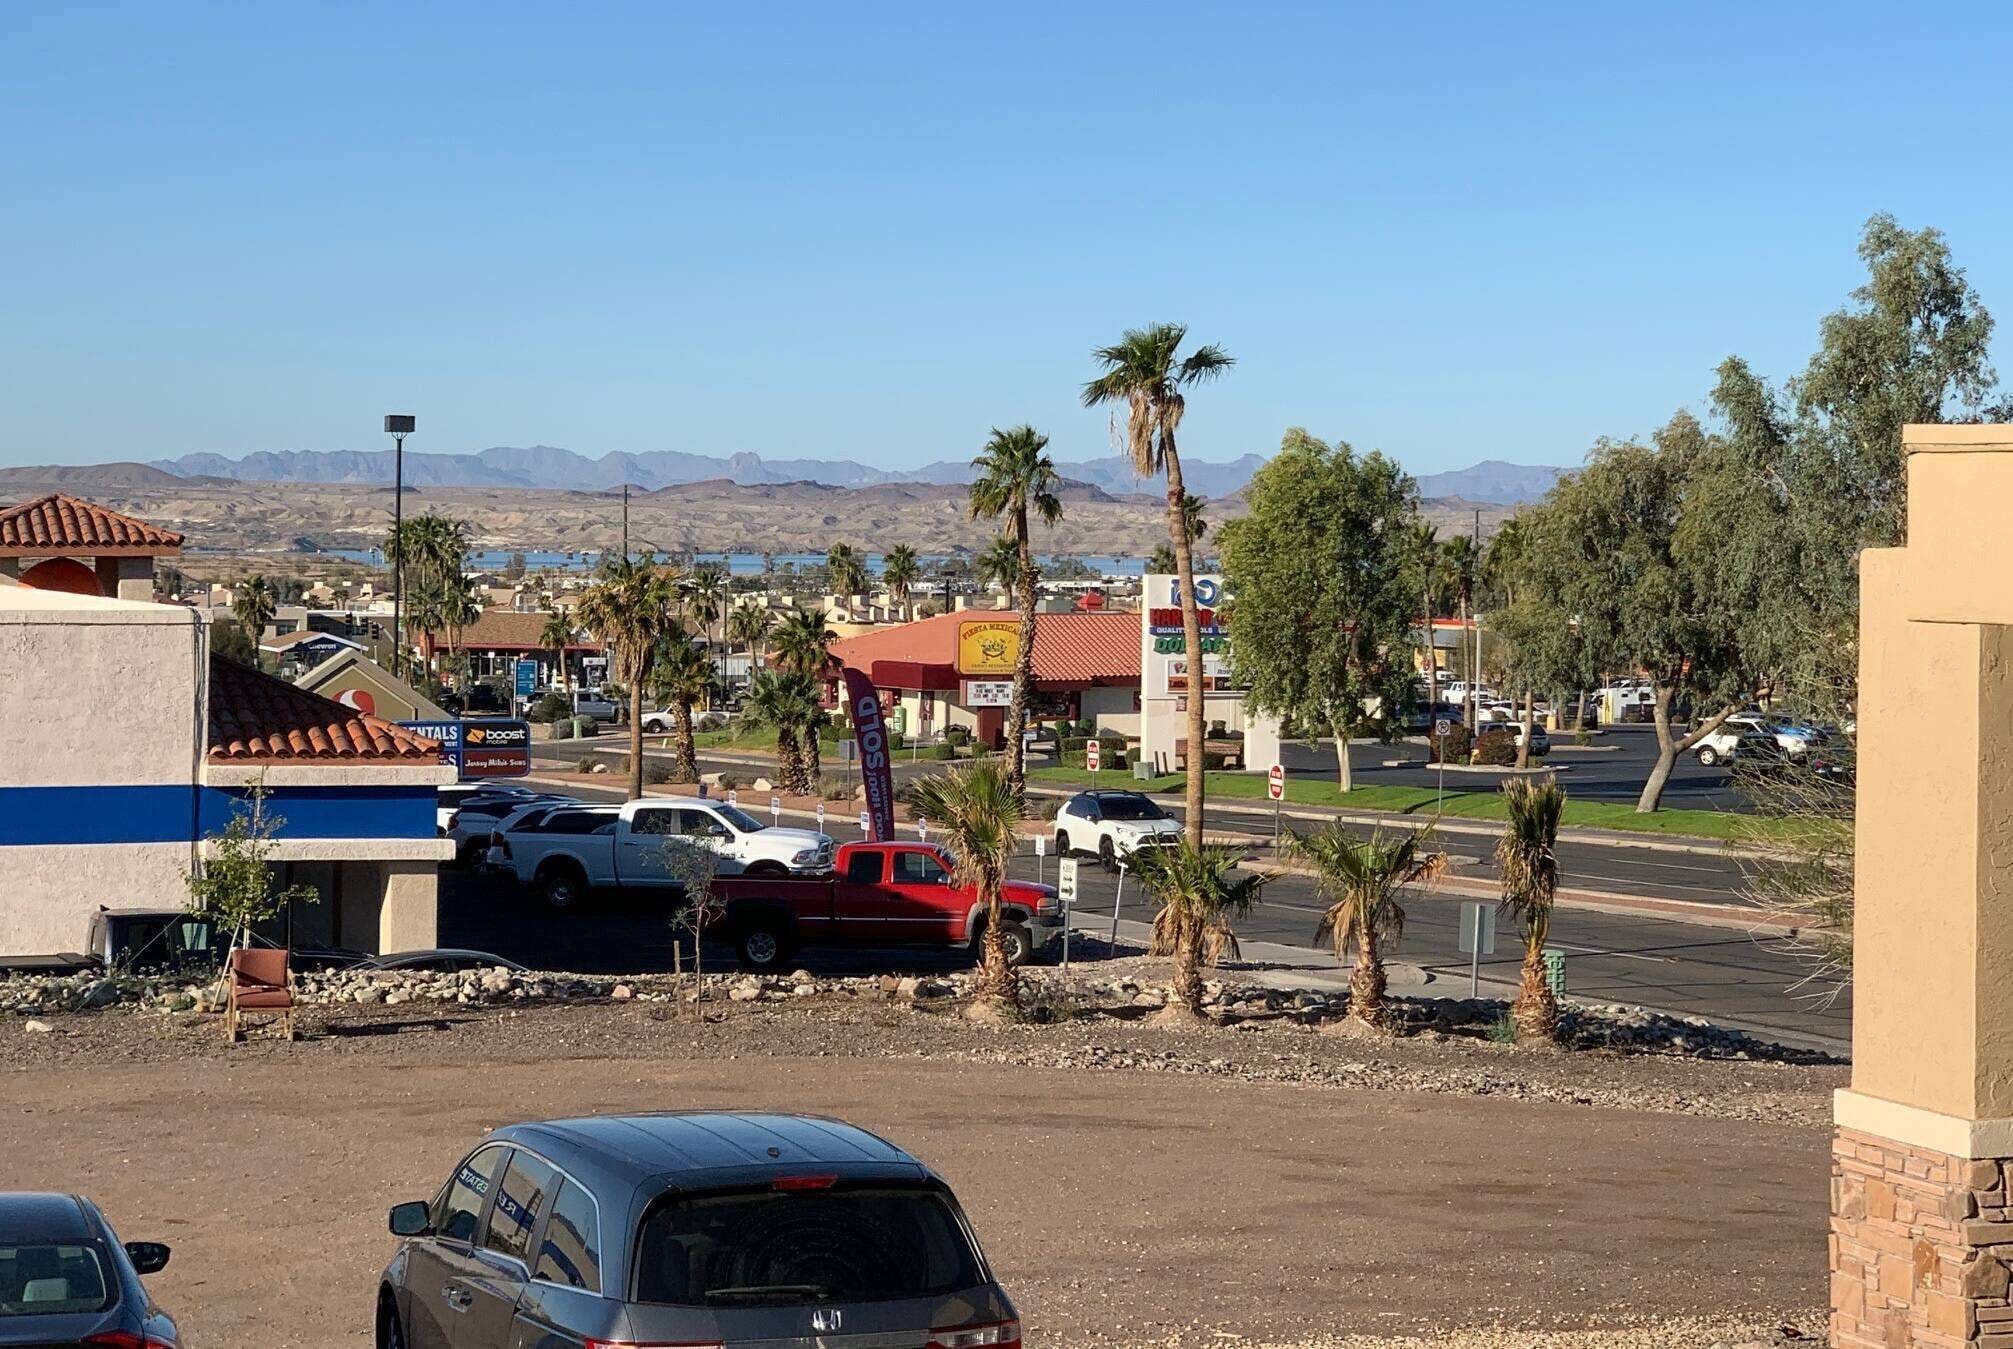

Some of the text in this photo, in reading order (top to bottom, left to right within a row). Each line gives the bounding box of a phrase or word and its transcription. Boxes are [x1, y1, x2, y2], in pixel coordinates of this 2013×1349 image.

[962, 623, 1018, 640] FIESTA MEXICA
[403, 726, 458, 740] NTALS
[486, 729, 525, 739] boost
[858, 696, 884, 769] SOLD
